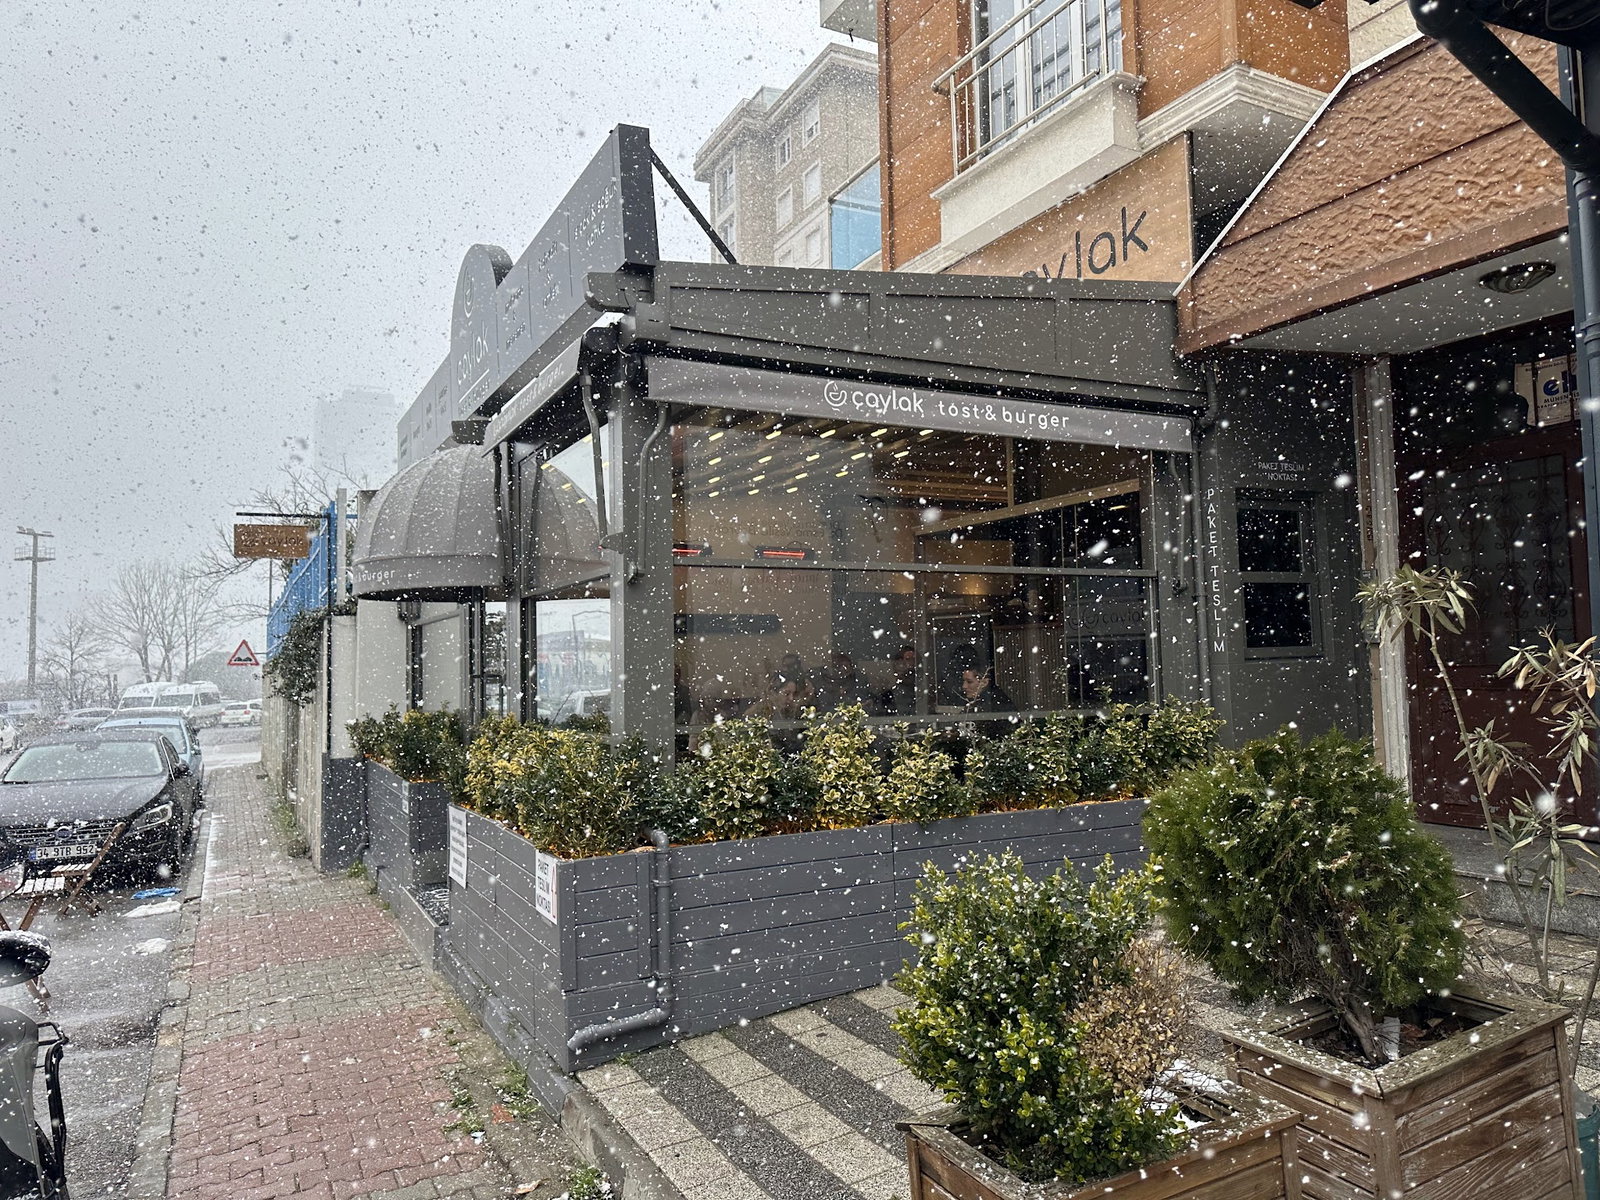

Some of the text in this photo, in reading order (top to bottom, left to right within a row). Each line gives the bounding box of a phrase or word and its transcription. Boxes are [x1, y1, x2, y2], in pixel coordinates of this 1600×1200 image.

[852, 389, 924, 414] çaylak
[1002, 406, 1070, 430] burger
[1207, 488, 1225, 652] PAKET TESLİM
[37, 848, 49, 858] 34
[76, 844, 94, 855] 952
